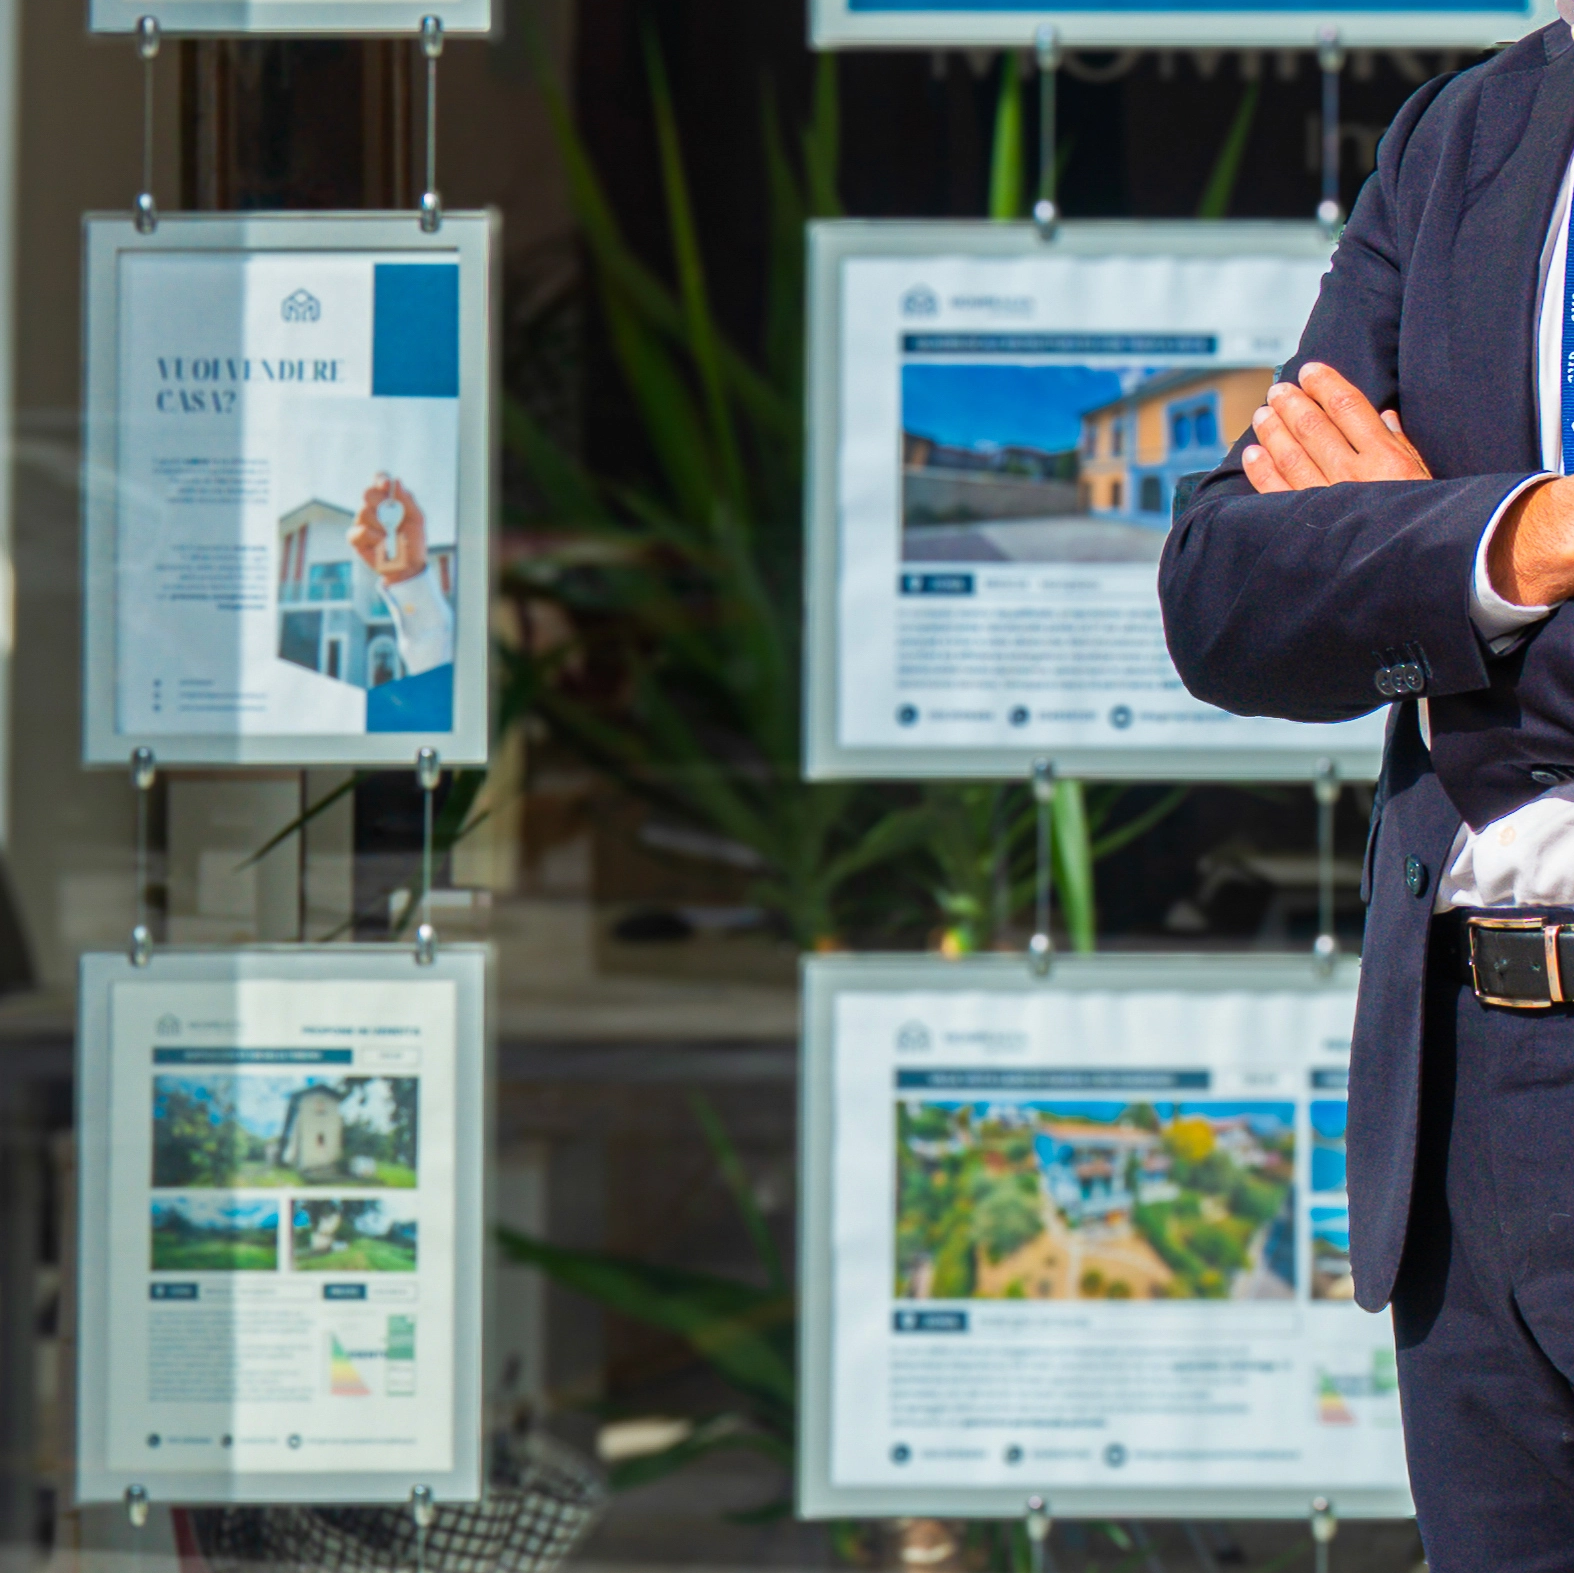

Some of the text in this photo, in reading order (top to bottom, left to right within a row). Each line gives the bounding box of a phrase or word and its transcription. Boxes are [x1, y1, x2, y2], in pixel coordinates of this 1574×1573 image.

[157, 356, 347, 384] VUOI VENDERE
[155, 388, 237, 414] CASA?
